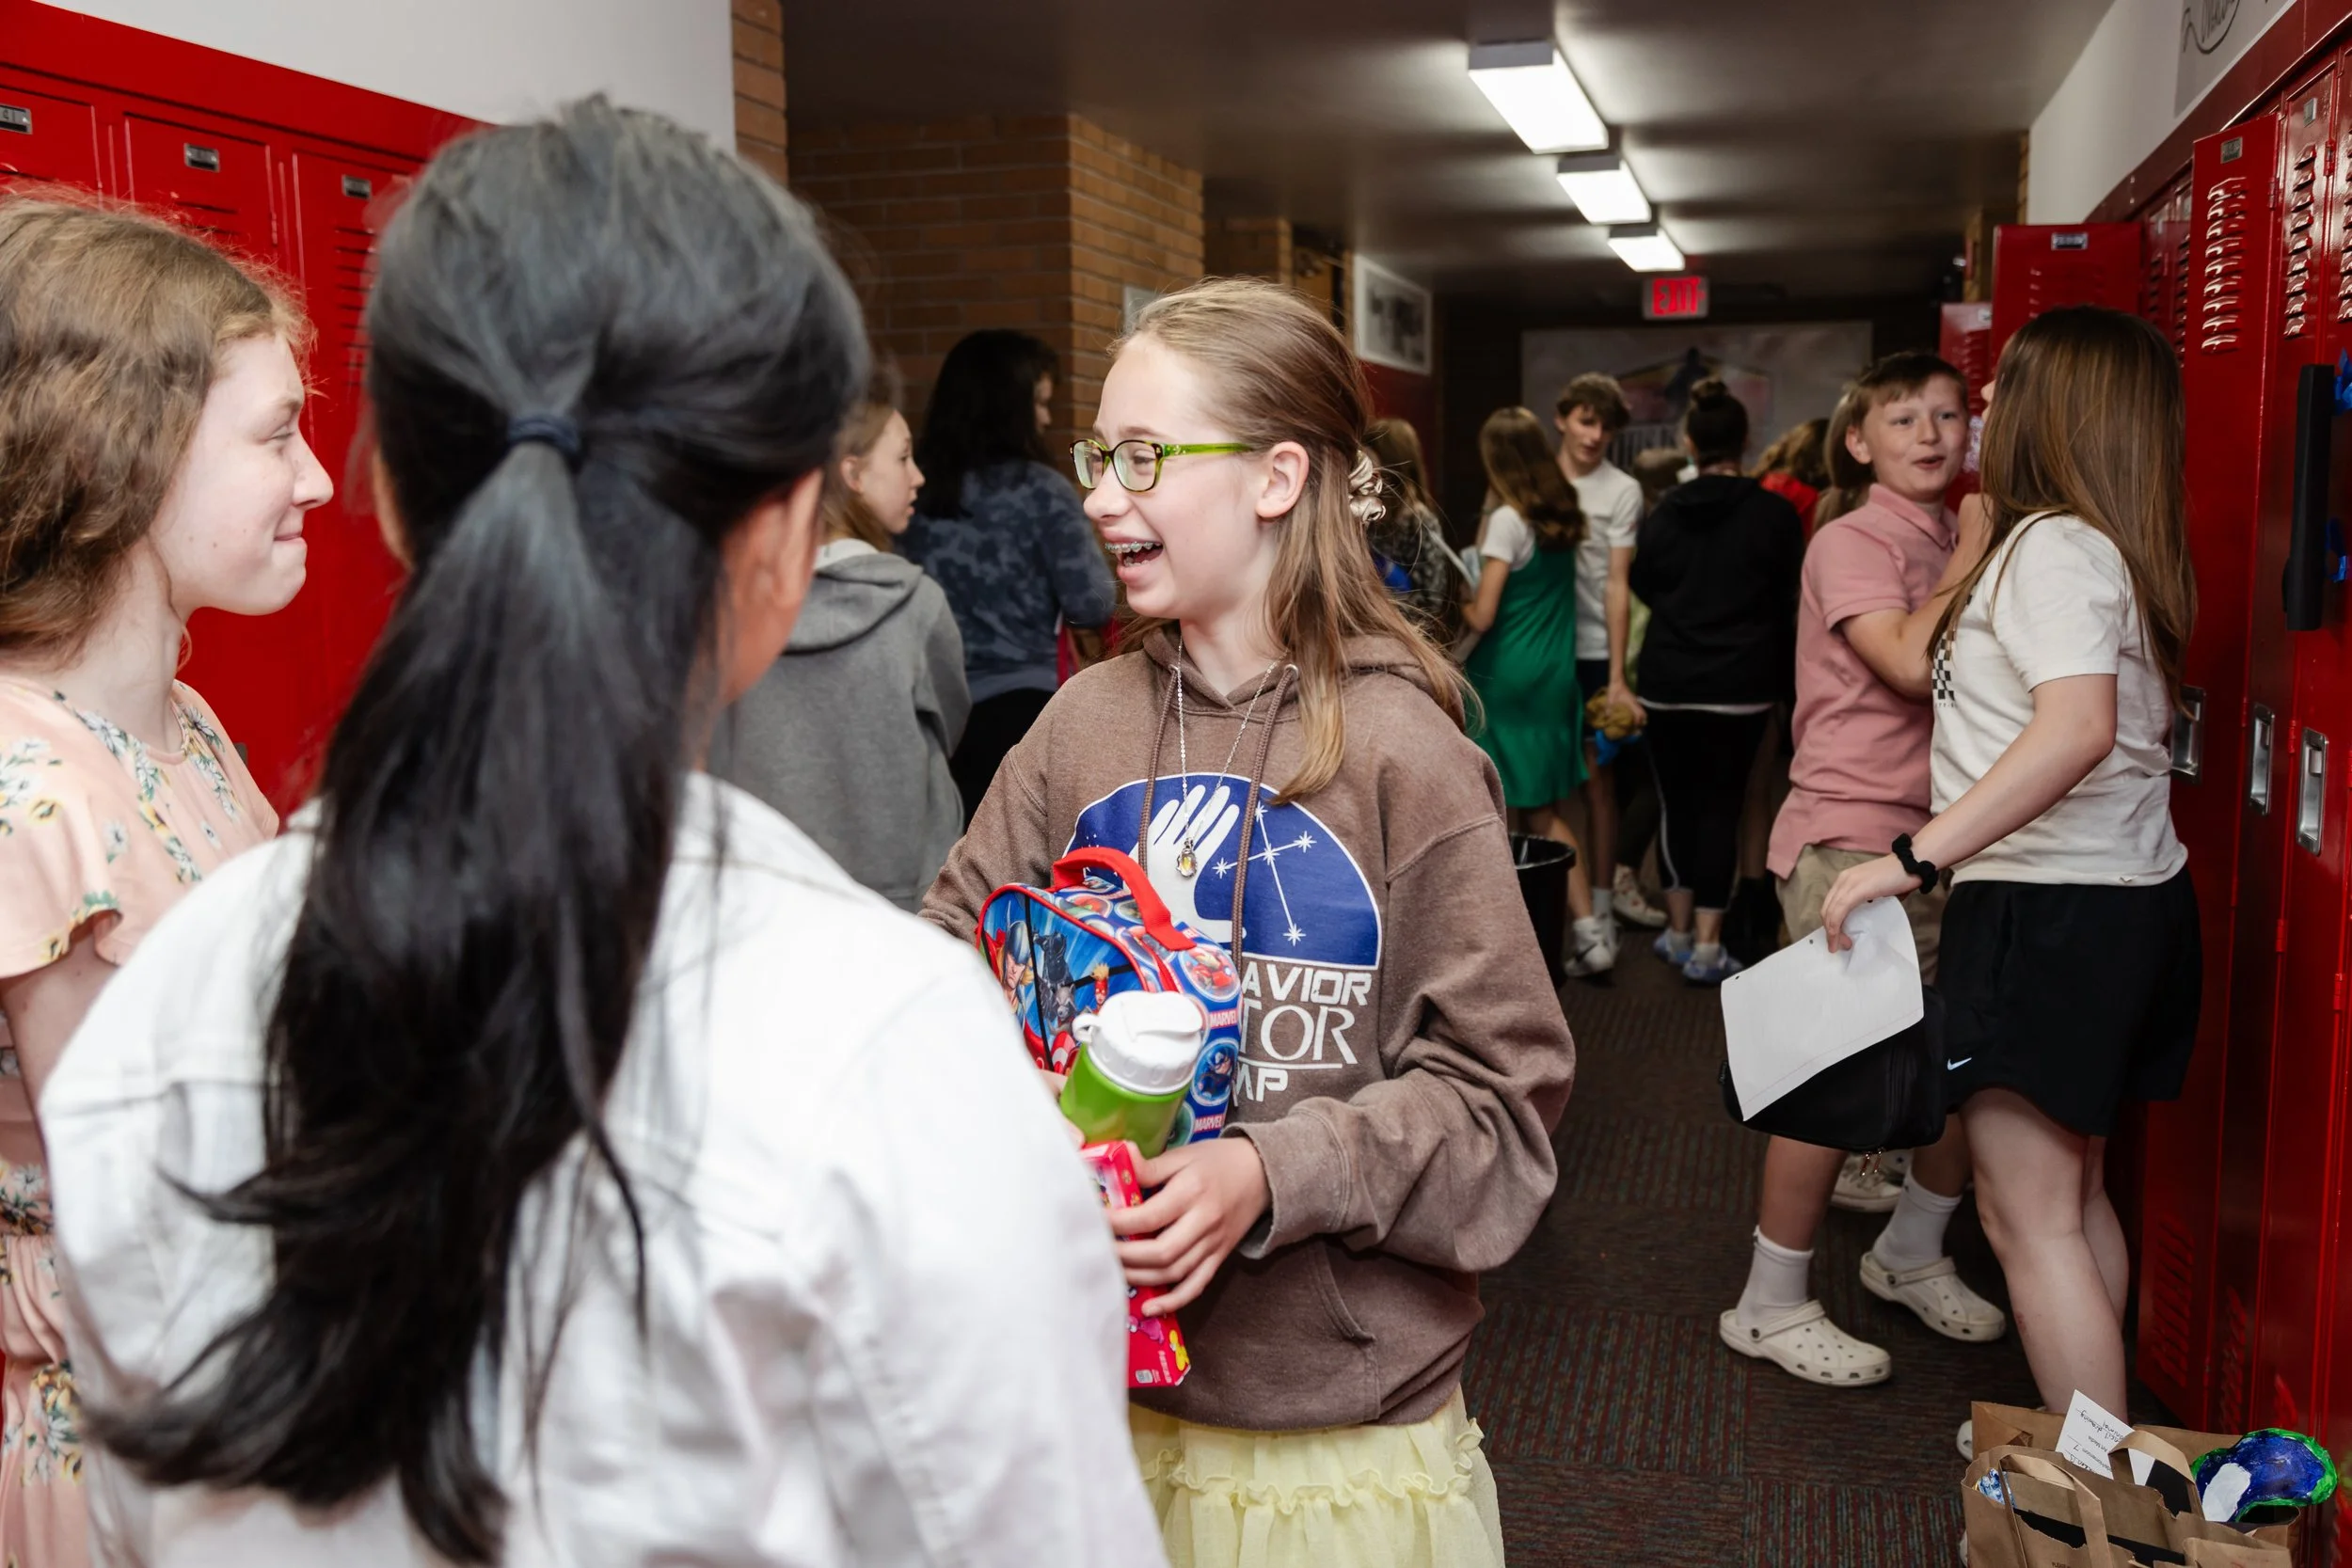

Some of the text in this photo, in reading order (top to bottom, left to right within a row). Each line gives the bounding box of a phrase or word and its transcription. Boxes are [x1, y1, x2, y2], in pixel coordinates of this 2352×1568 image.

[1653, 277, 1701, 316] EXIT
[1210, 1009, 1238, 1029] MARVEL
[1194, 1115, 1223, 1132] MARVEL
